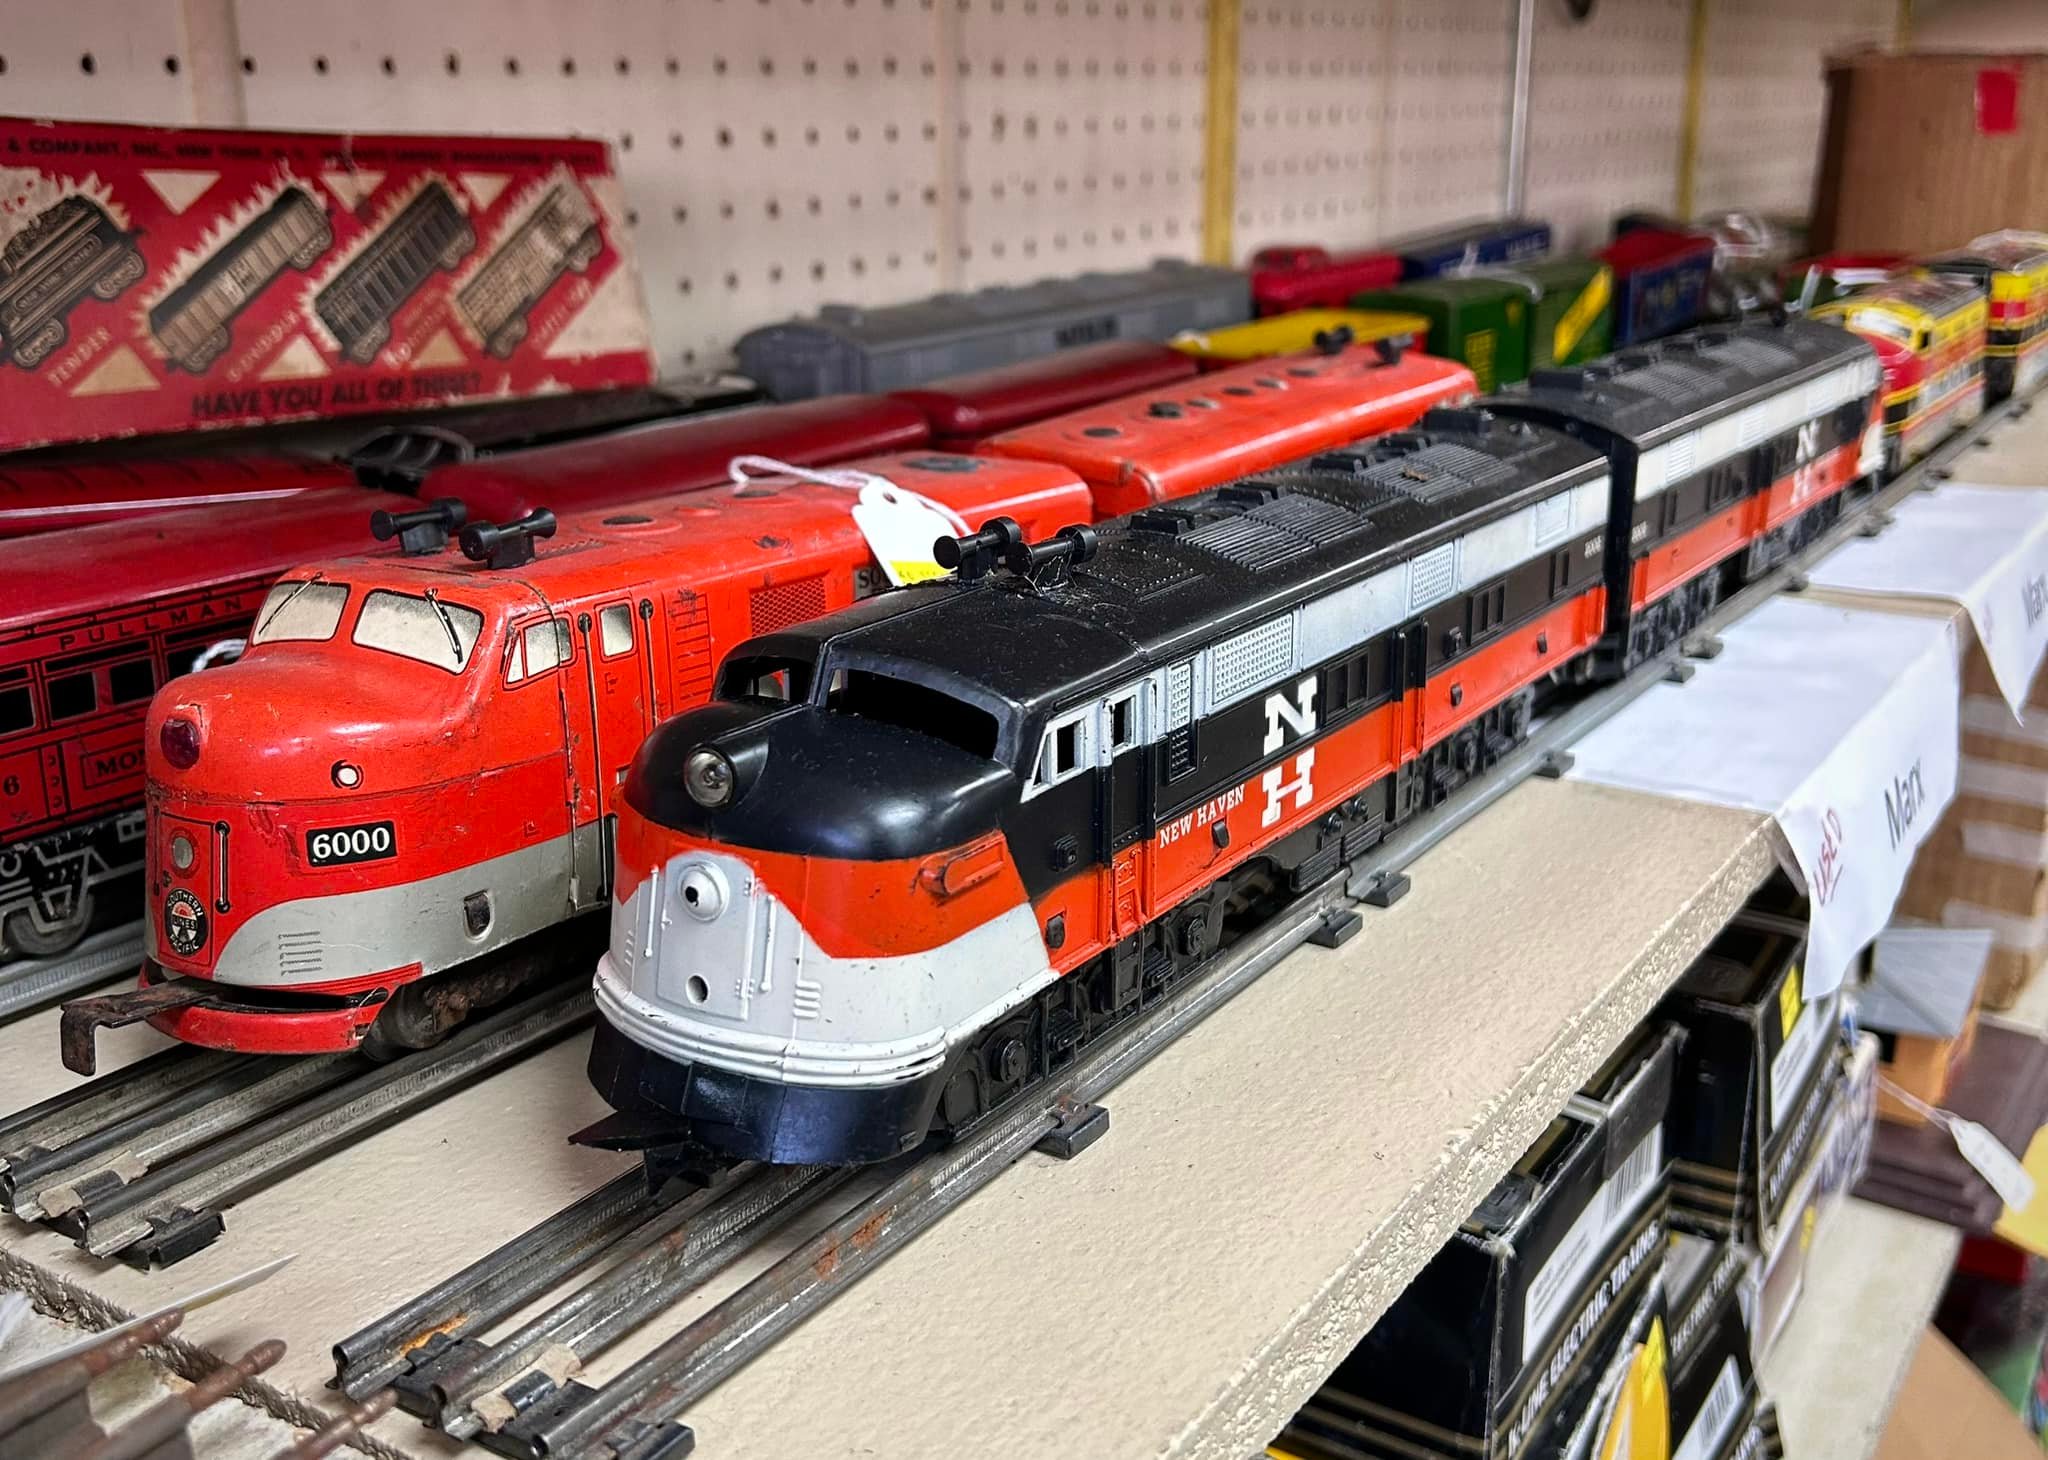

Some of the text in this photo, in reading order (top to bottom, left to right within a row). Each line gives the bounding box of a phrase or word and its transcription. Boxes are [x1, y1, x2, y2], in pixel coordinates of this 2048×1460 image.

[191, 387, 264, 417] HAVE
[270, 382, 322, 410] YOU
[331, 380, 368, 405] ALL
[59, 597, 243, 650] PULLMAN
[1159, 783, 1246, 849] NEW HAVEN
[311, 826, 391, 859] 6000
[167, 889, 204, 917] SOUTHERN
[169, 934, 200, 954] PACIFIC
[1550, 1280, 1612, 1387] ELECTRIC
